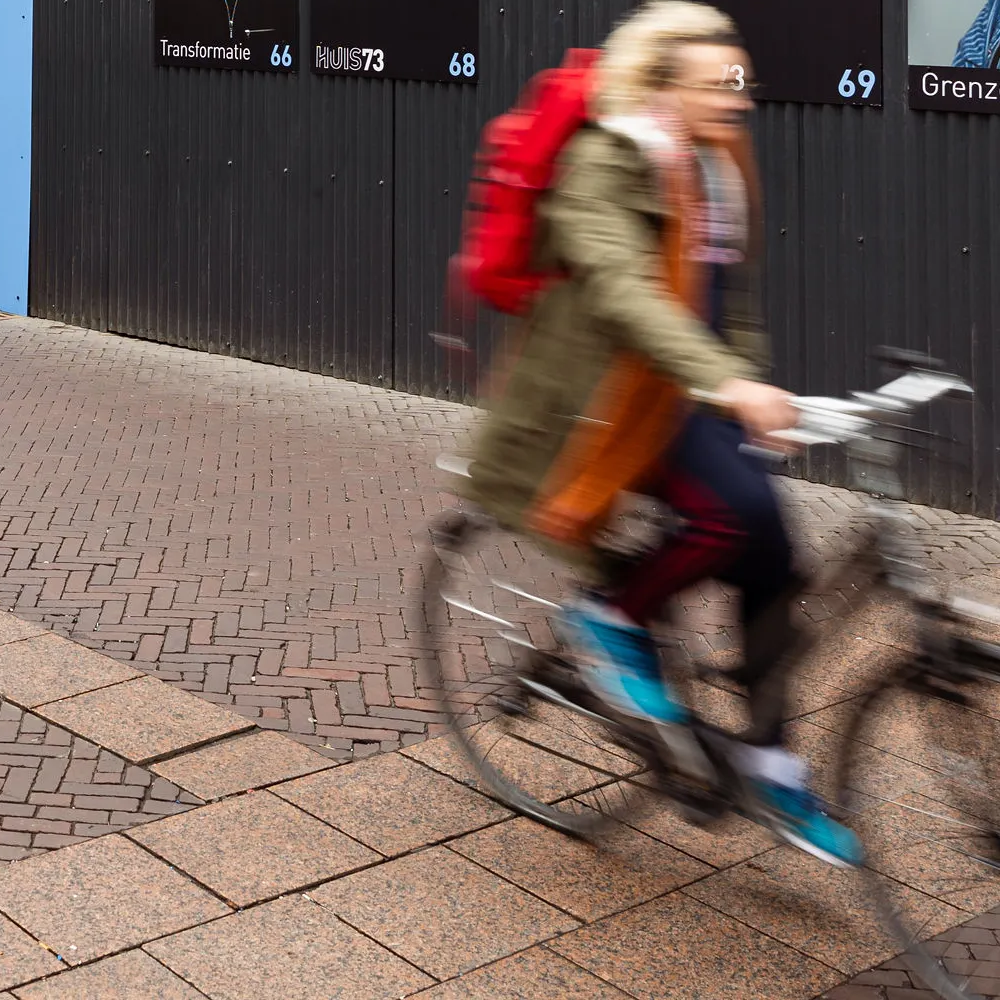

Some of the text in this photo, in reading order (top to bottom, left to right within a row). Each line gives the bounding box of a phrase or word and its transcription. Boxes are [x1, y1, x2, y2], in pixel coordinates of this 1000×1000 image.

[160, 40, 293, 67] Transformatie 66
[315, 45, 476, 78] HUIS73 68
[838, 69, 876, 99] 69
[922, 72, 1000, 100] Grenz
